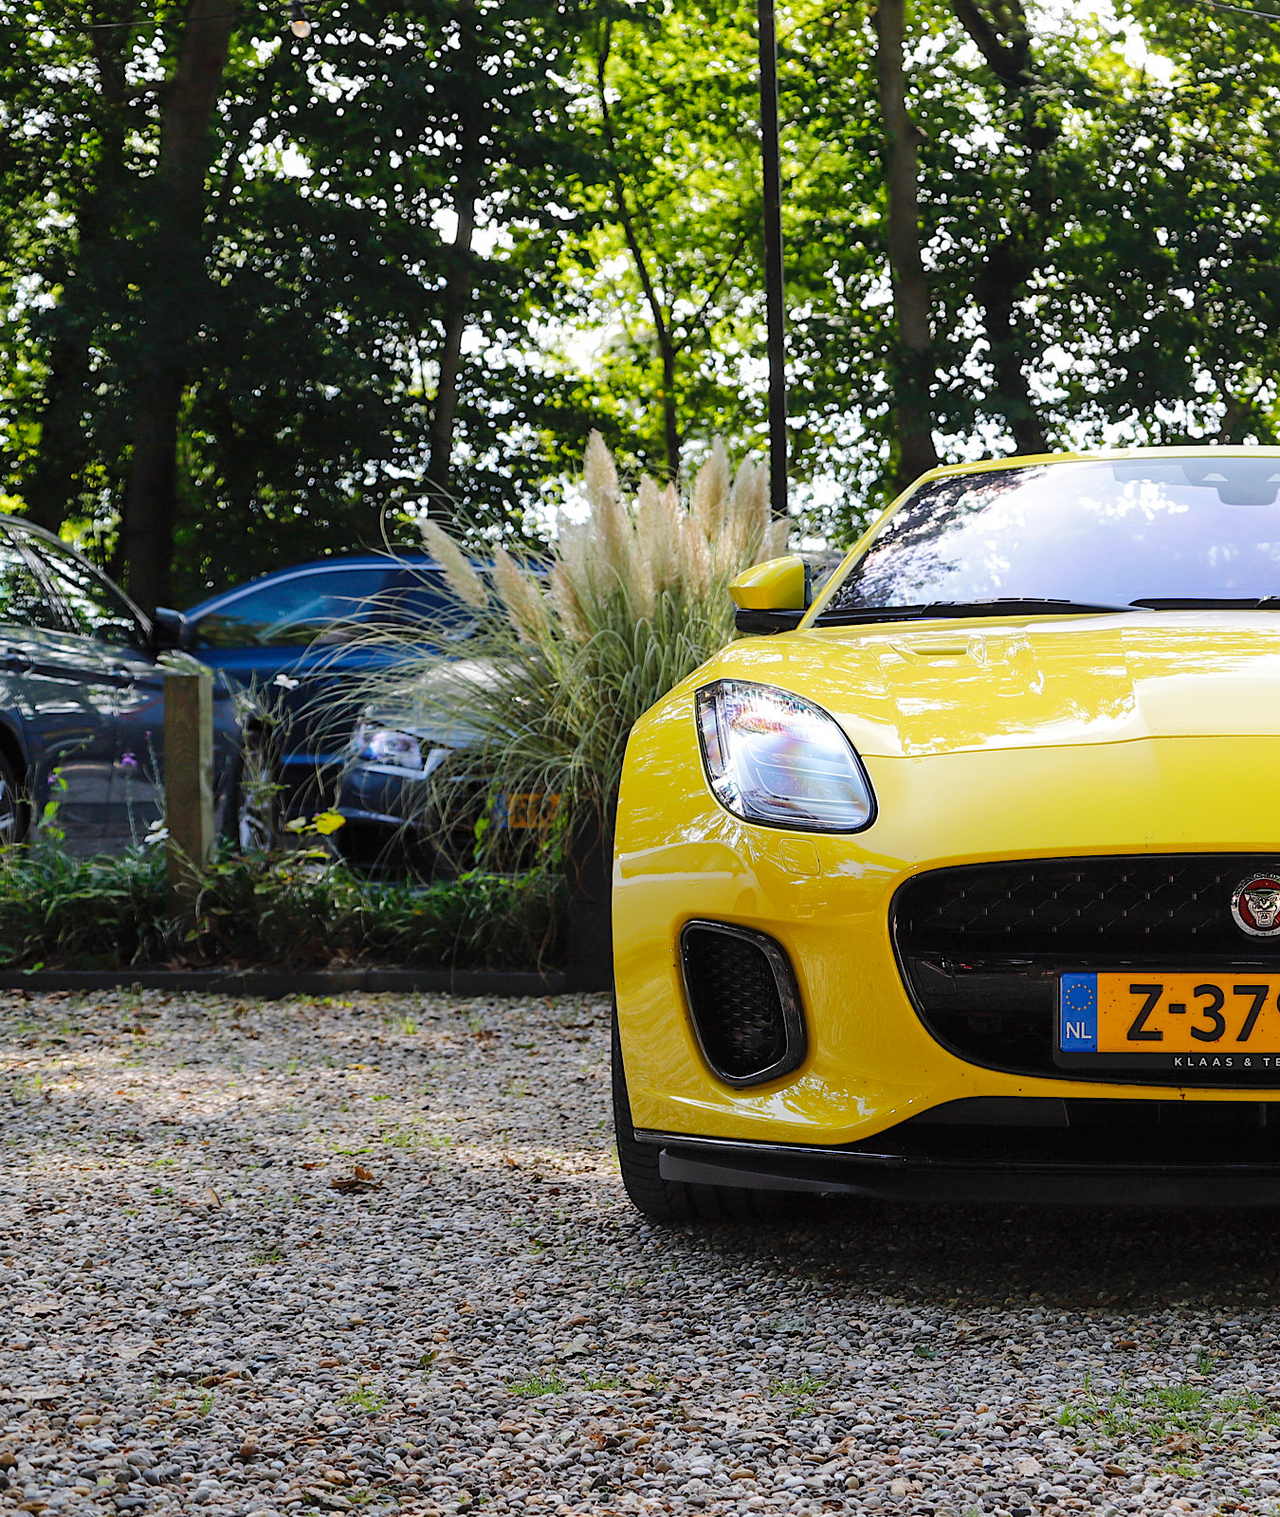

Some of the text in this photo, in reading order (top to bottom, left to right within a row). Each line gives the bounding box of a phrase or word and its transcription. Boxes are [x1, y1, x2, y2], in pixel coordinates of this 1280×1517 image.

[1066, 1022, 1092, 1039] NL
[1174, 1057, 1233, 1067] KLAAS
[1244, 1057, 1252, 1067] &
